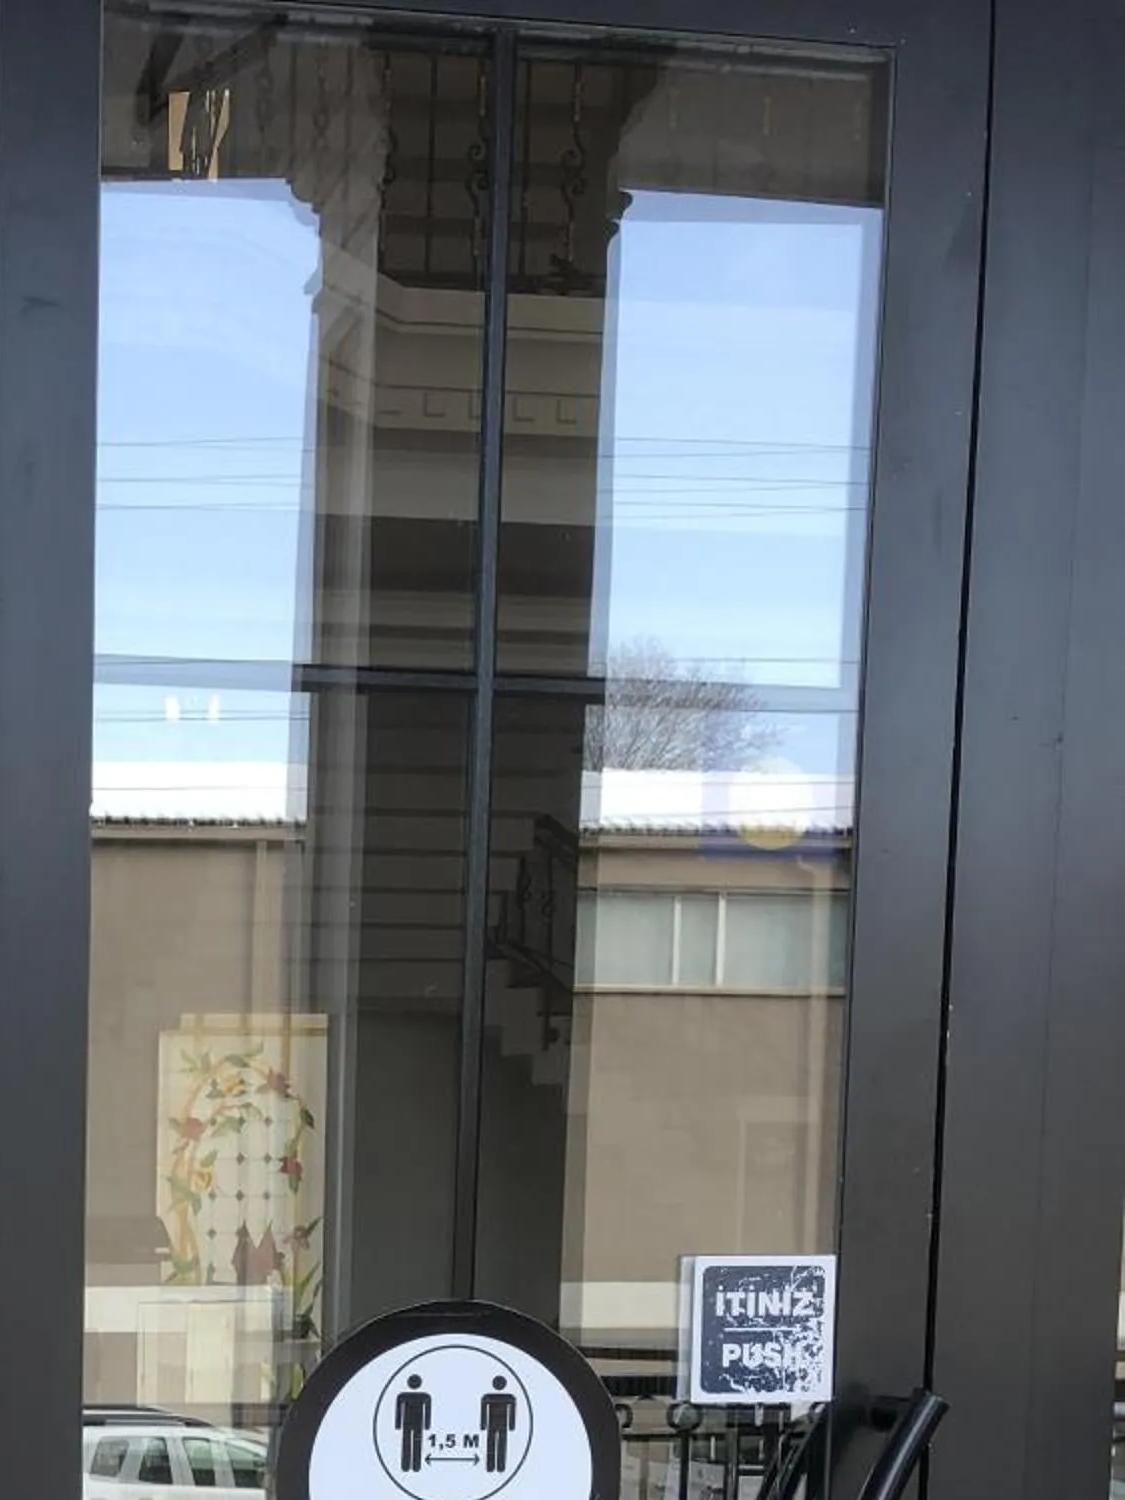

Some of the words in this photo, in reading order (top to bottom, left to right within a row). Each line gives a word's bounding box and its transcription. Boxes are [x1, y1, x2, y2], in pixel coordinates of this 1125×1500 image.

[715, 1284, 816, 1318] İTİNİZ
[722, 1342, 804, 1370] PUSH
[427, 1433, 457, 1451] 1,5
[463, 1433, 480, 1449] M
